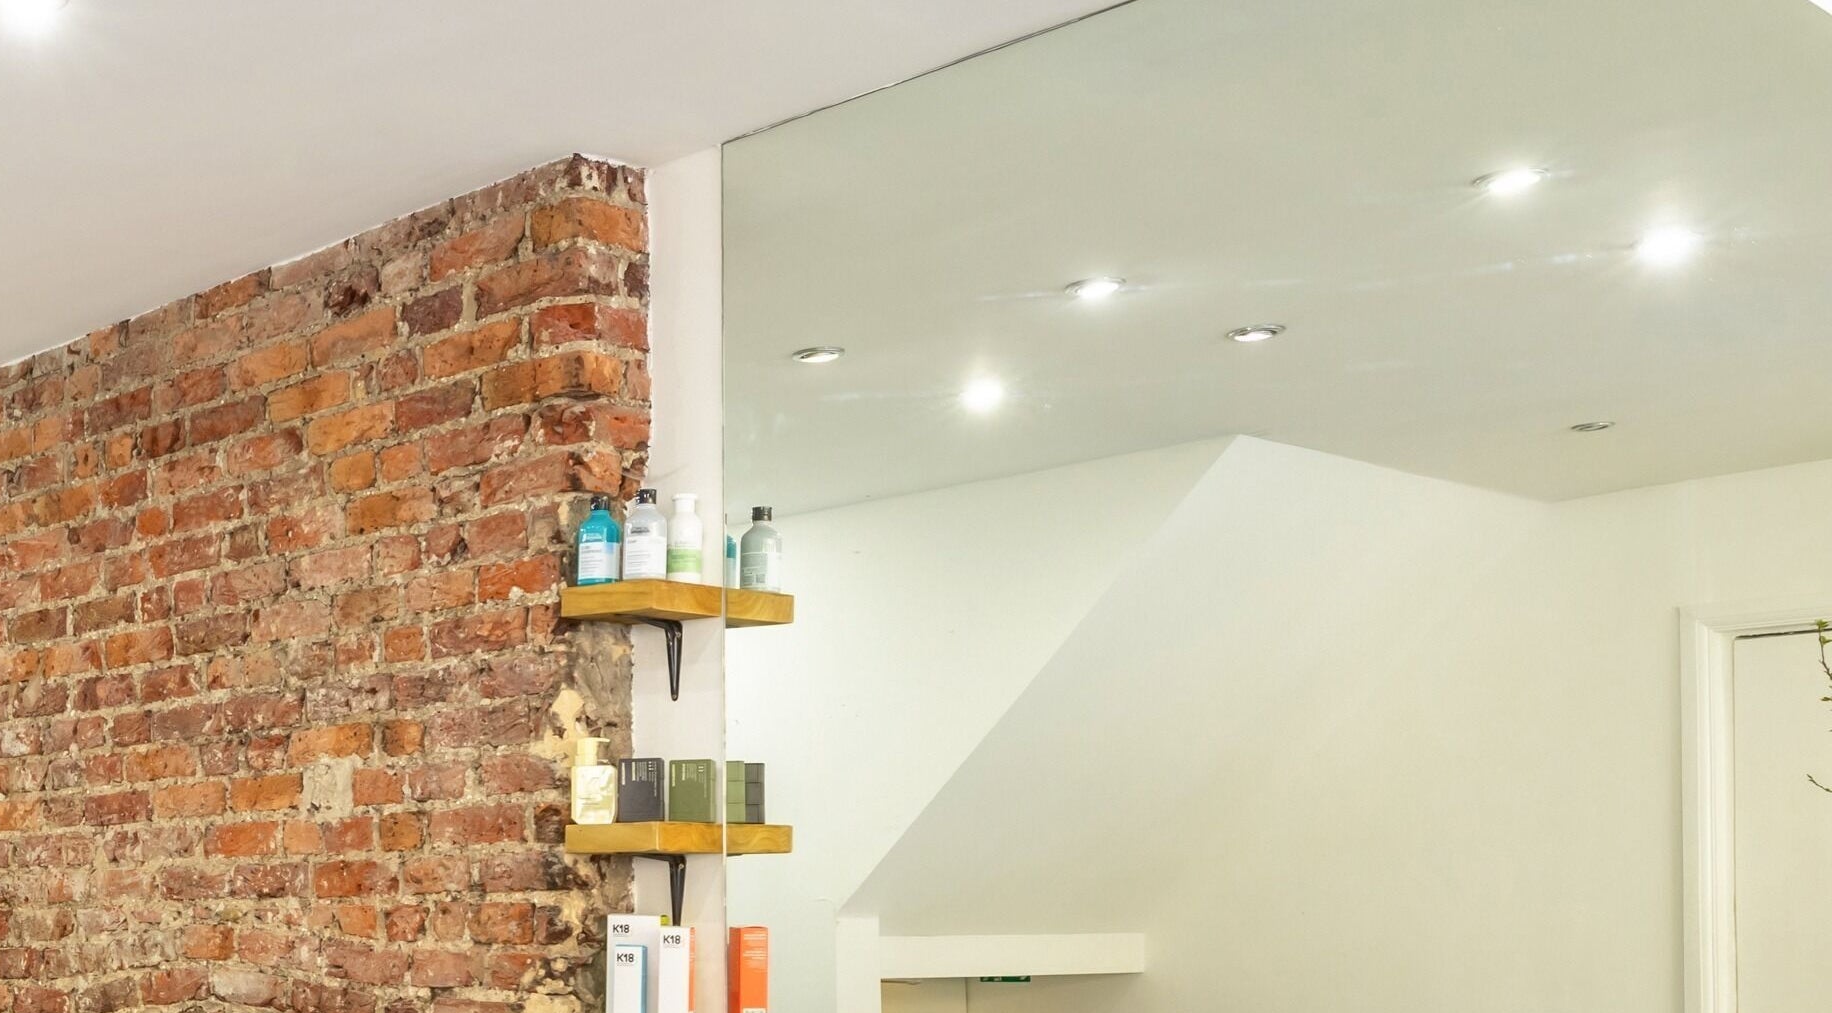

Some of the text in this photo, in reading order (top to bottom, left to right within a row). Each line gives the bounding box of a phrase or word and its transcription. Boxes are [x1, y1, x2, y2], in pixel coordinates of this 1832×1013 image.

[613, 924, 630, 934] K18
[663, 935, 681, 945] K18
[616, 953, 634, 963] K18
